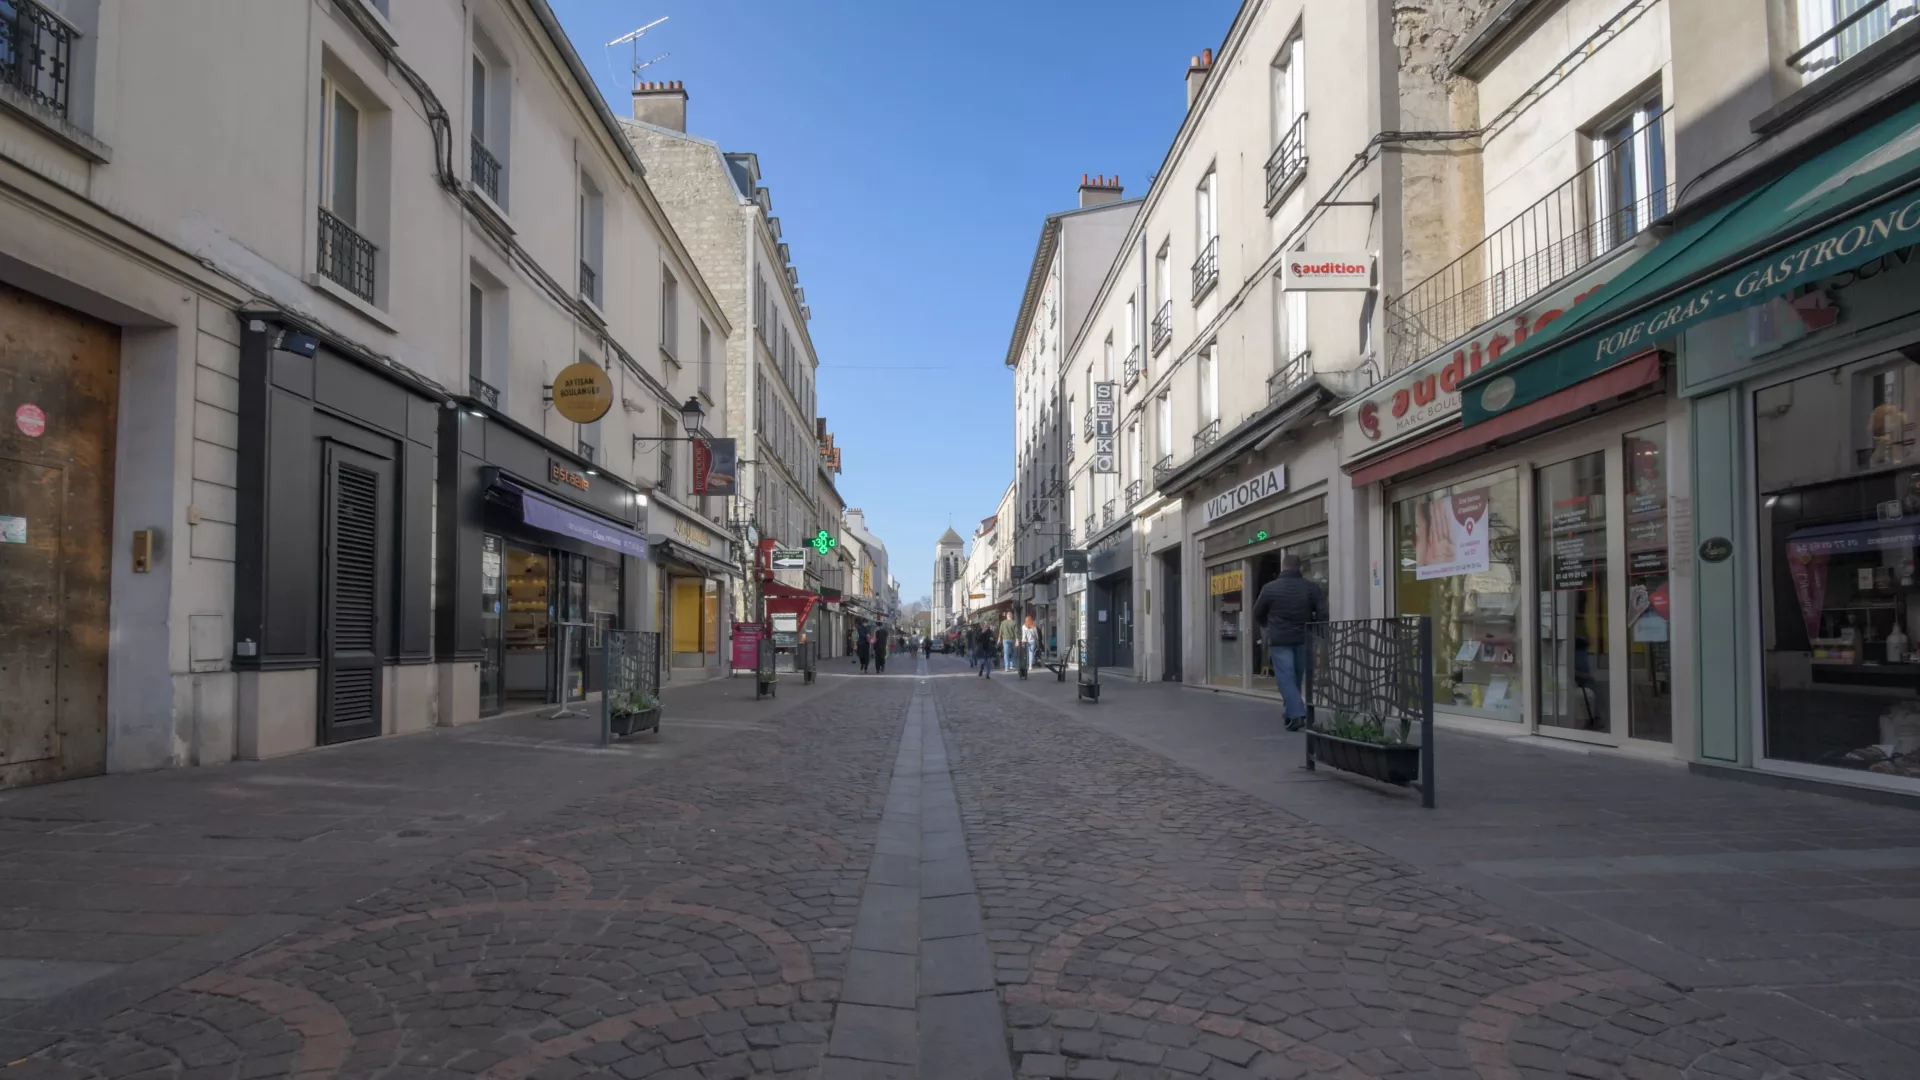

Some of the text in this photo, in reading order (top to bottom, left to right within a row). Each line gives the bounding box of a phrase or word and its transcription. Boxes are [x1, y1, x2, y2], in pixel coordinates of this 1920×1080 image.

[1303, 263, 1365, 274] audition
[1595, 320, 1644, 362] FOIE
[1647, 290, 1712, 336] GRAS
[564, 376, 594, 387] ARTISAN
[560, 386, 600, 398] BOULANGER
[1097, 385, 1113, 472] SEIKO
[1396, 411, 1424, 431] MARC
[1207, 470, 1279, 520] VICTORIA
